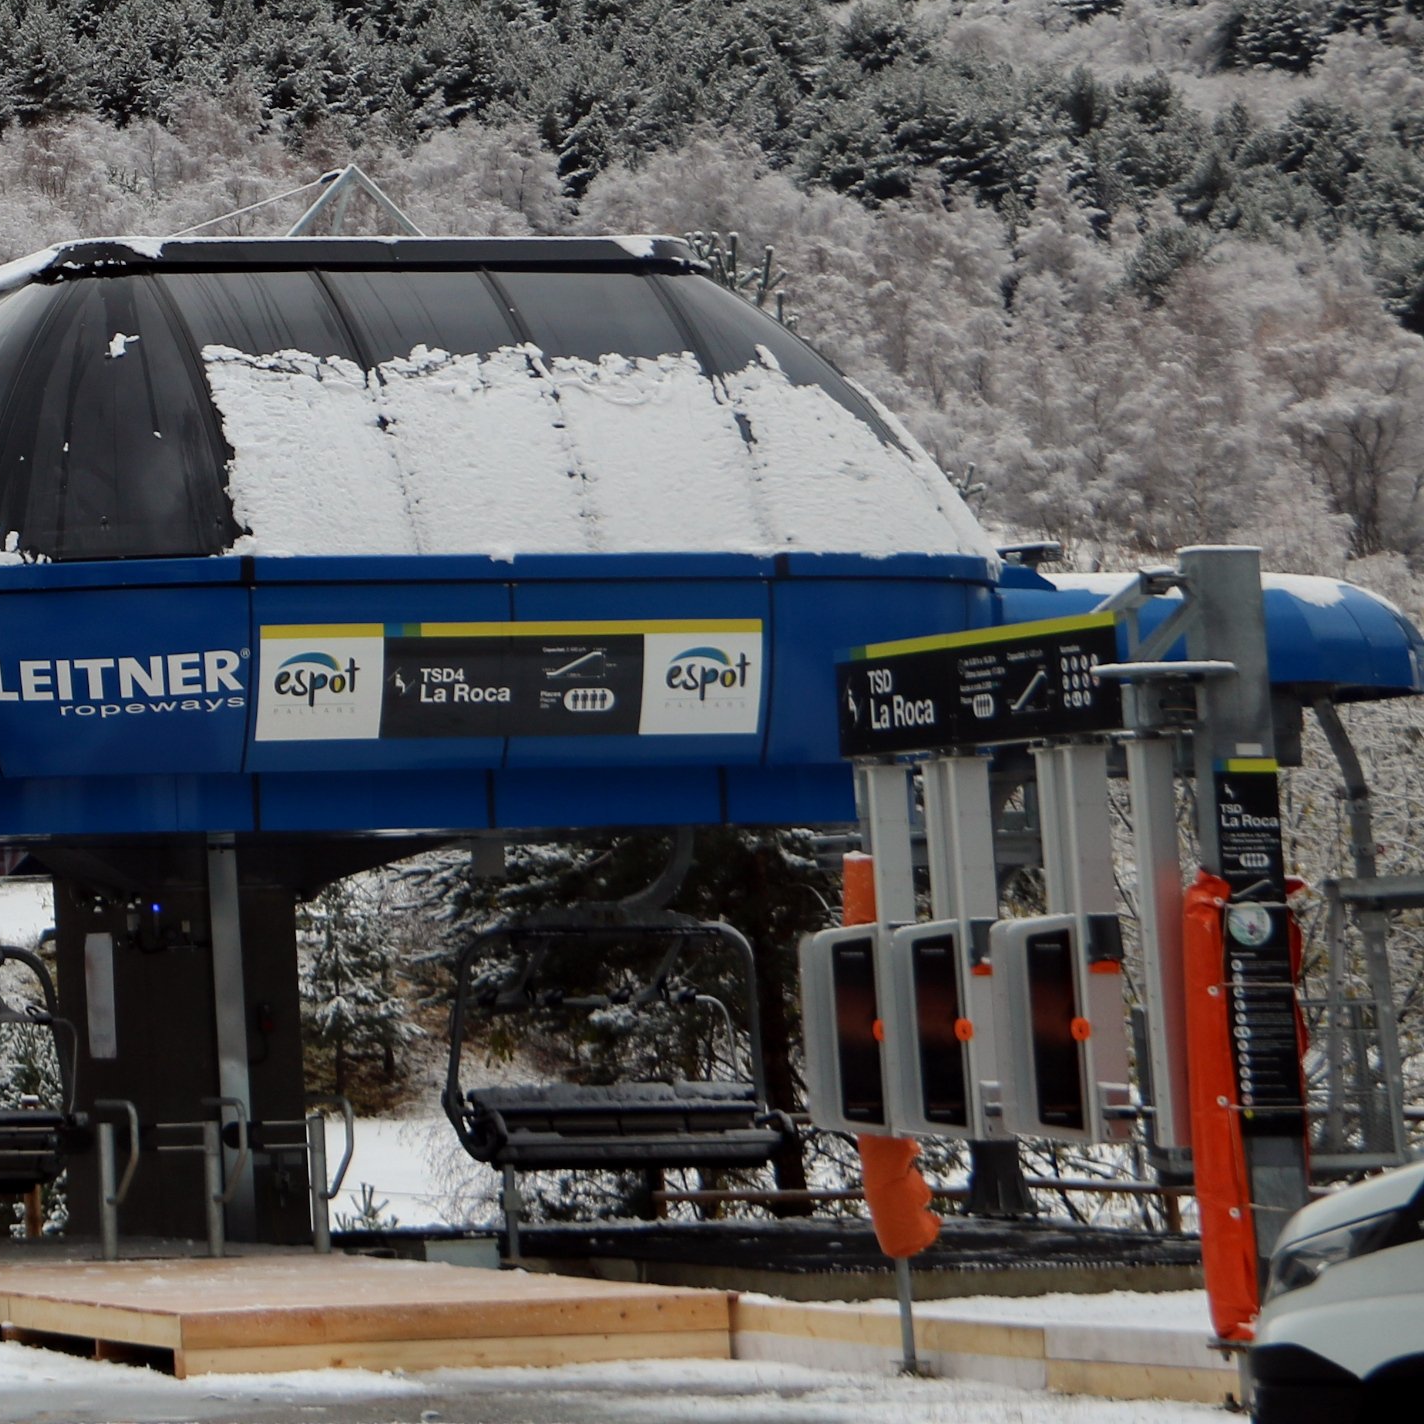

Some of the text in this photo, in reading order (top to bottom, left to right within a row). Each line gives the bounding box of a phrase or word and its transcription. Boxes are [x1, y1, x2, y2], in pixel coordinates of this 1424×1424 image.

[274, 657, 360, 707] espot
[420, 668, 465, 683] TSD4
[666, 652, 751, 701] espot
[867, 669, 892, 695] TSD
[420, 683, 511, 703] La Roca
[60, 695, 245, 718] ropeways
[870, 694, 935, 730] La Roca
[1219, 803, 1243, 814] TSD
[1221, 814, 1280, 827] La Roca
